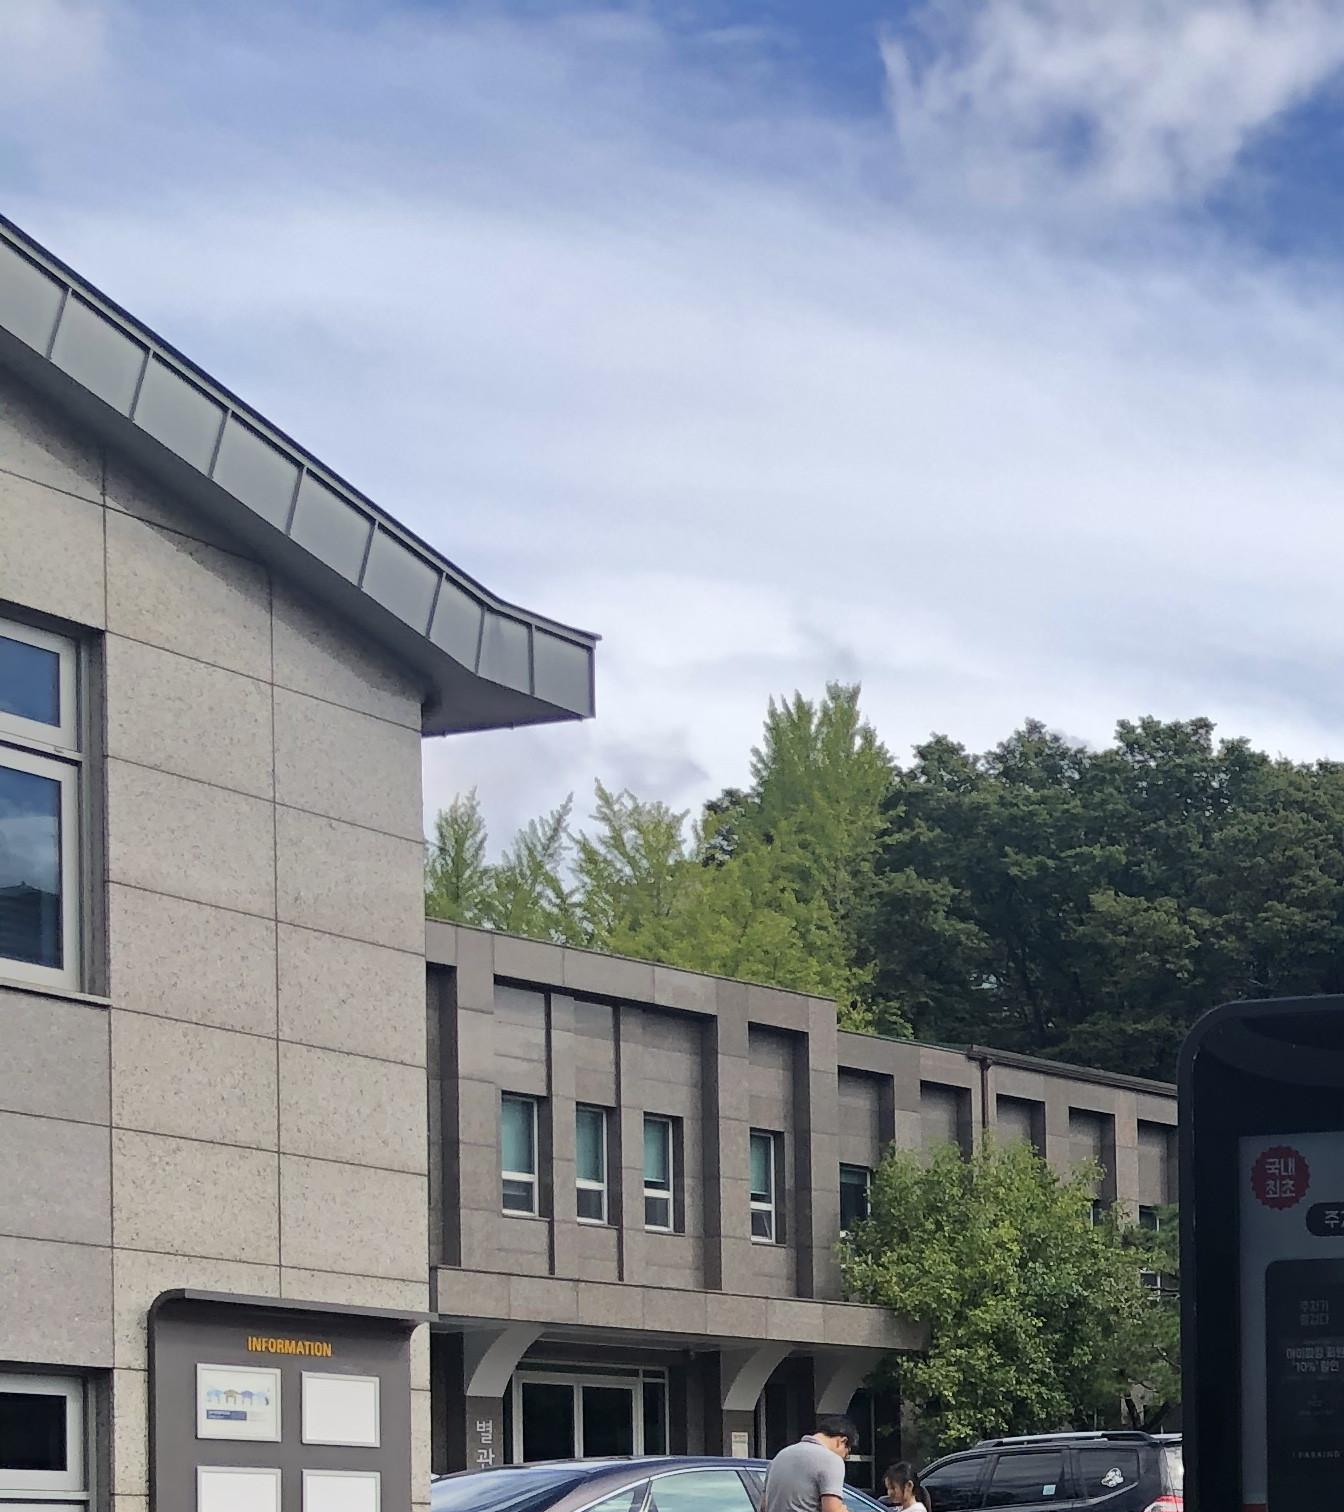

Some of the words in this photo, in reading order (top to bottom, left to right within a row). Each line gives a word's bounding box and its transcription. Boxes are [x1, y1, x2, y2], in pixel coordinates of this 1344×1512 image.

[1265, 1157, 1295, 1175] 국내
[1265, 1178, 1296, 1198] 최초
[248, 1336, 332, 1357] INFORMATION
[476, 1420, 495, 1469] 별관
